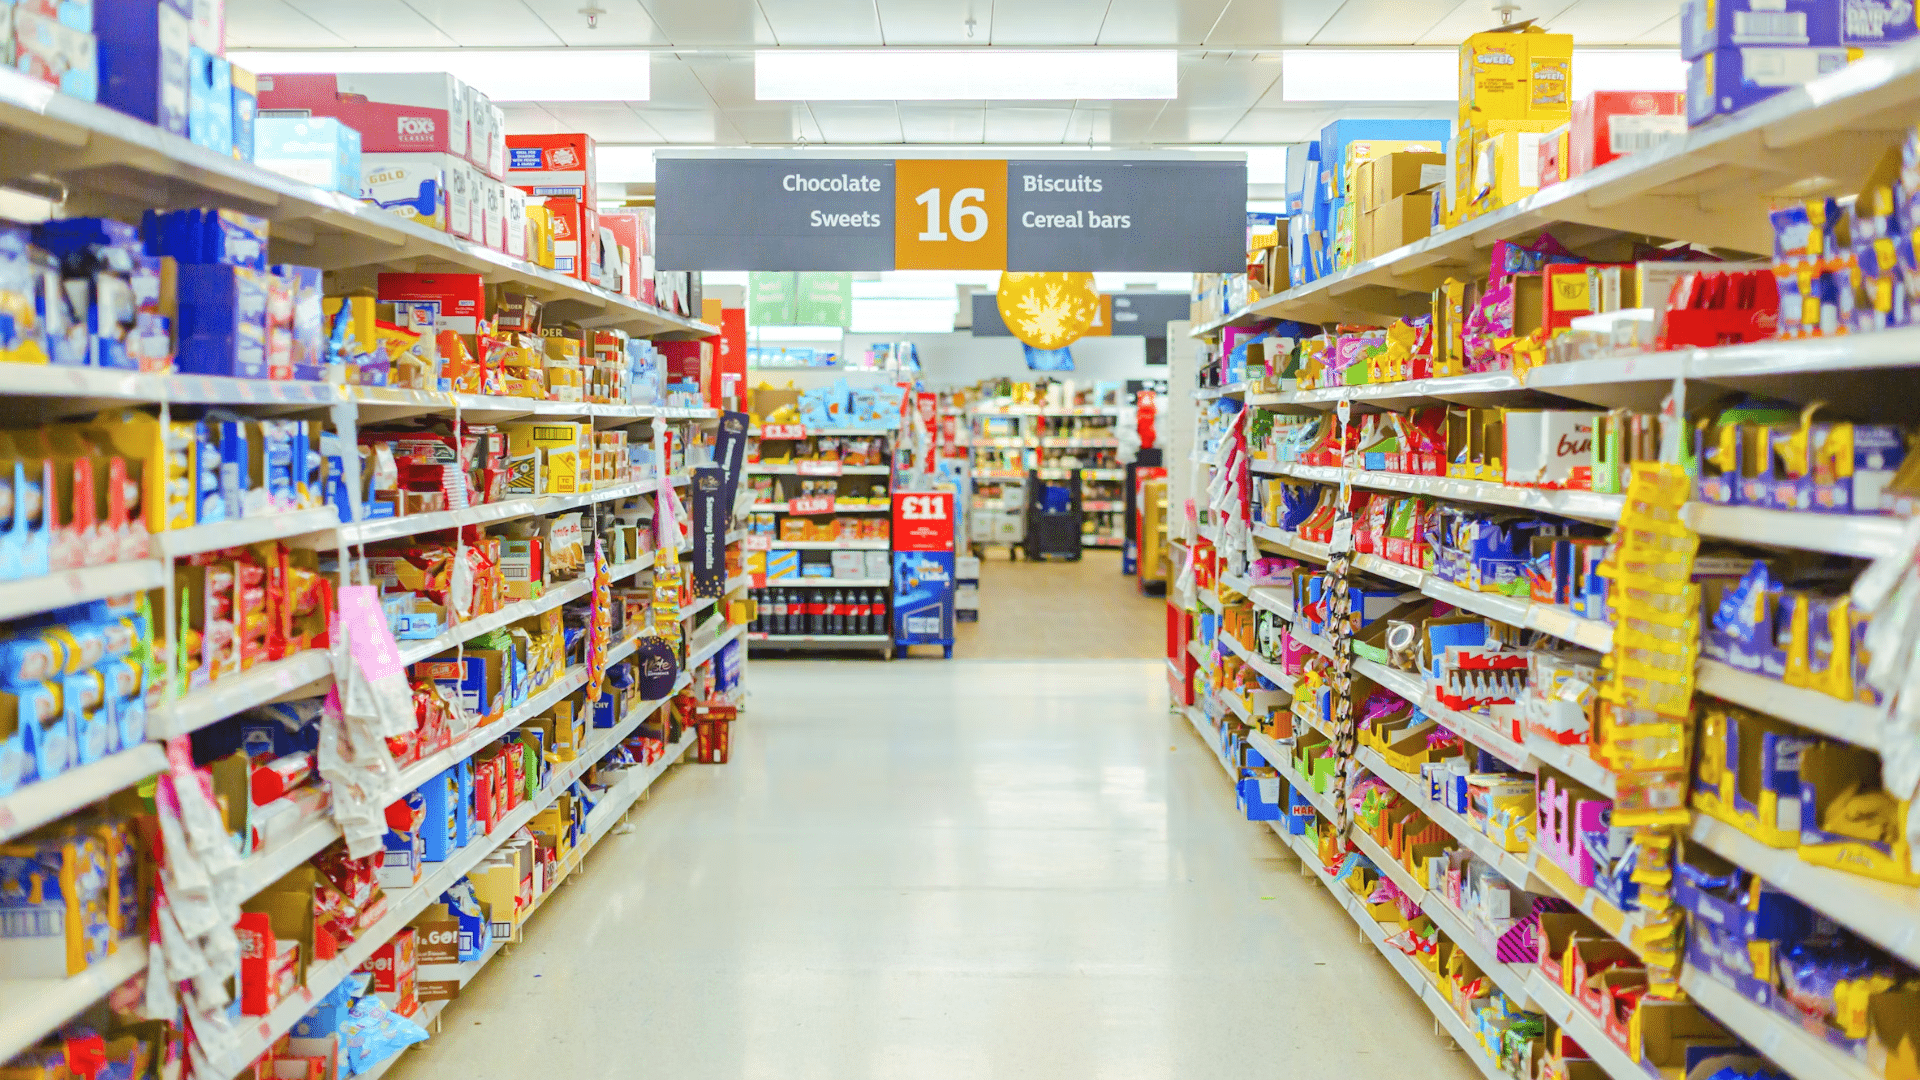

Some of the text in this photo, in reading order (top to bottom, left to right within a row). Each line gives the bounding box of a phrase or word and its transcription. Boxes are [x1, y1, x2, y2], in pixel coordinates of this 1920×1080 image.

[1845, 21, 1885, 37] MILK
[1477, 54, 1515, 65] SWEETS
[1534, 71, 1565, 81] SWEETS
[369, 171, 404, 184] GOLD
[782, 174, 881, 193] Chocolate
[1023, 174, 1103, 193] Biscuits
[810, 209, 881, 229] Sweets
[915, 187, 988, 242] 16
[1022, 210, 1131, 229] Cereal bars
[541, 329, 563, 337] DER
[902, 496, 946, 520] £11
[704, 496, 714, 569] Savoury biscuits
[1292, 805, 1315, 816] HAR
[429, 930, 458, 945] GO!
[363, 957, 392, 971] GO!
